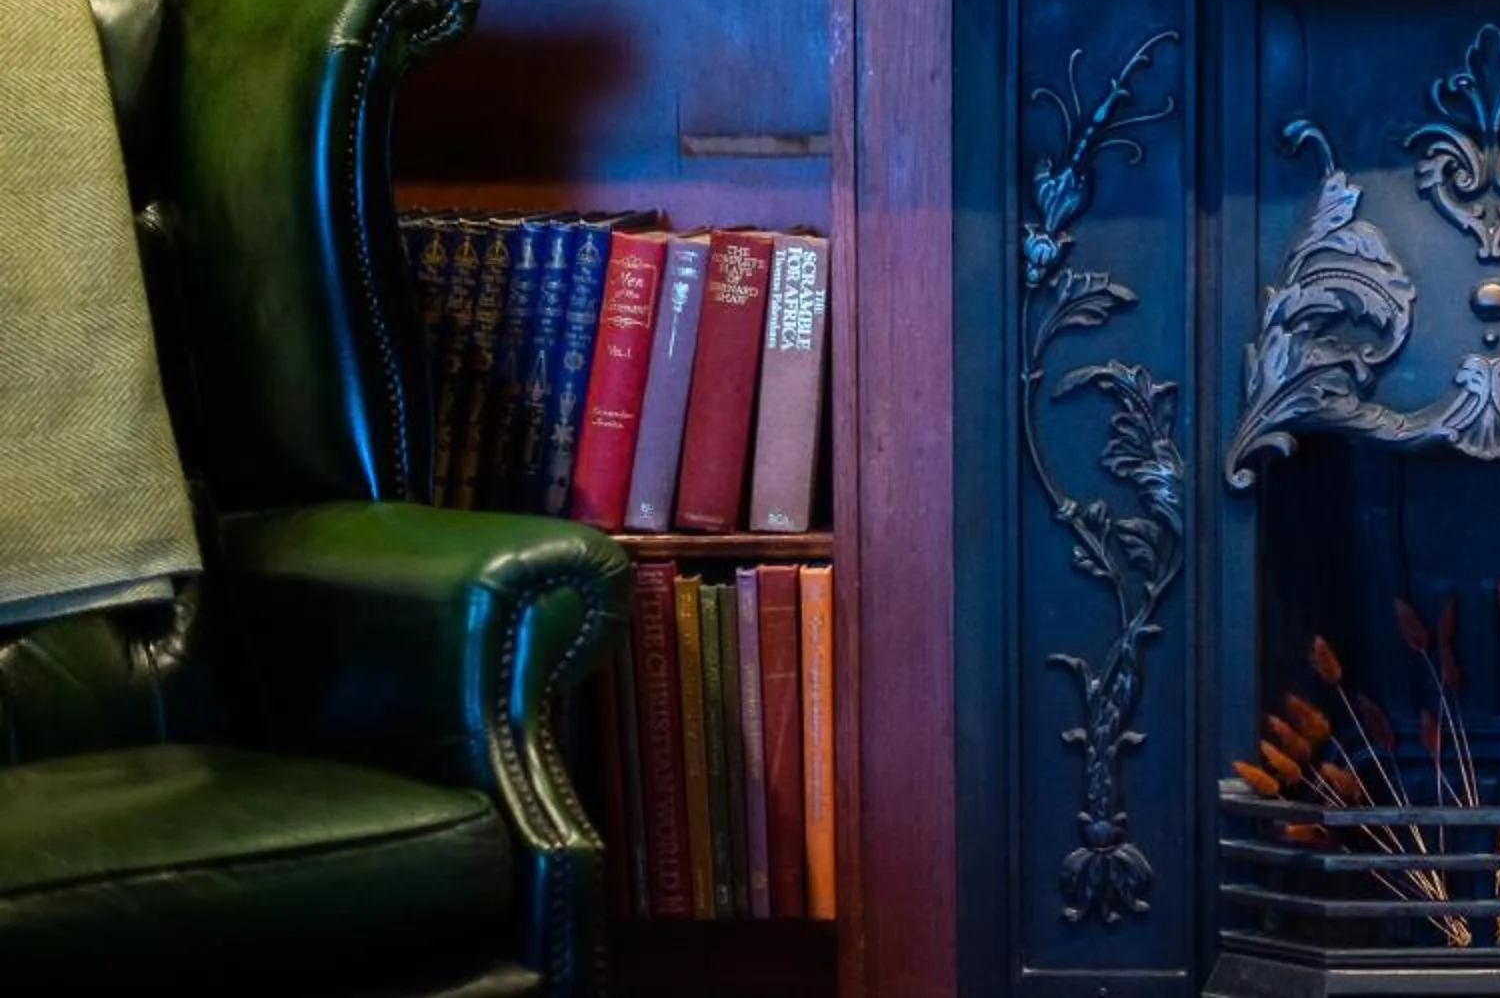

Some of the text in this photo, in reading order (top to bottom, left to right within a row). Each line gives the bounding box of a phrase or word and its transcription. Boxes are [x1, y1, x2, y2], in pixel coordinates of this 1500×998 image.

[773, 250, 787, 291] Thomas
[780, 246, 803, 351] FOR AFRICA
[796, 251, 817, 351] SCRAMBLE
[815, 290, 826, 315] THE
[644, 653, 675, 793] CHRISTIAN
[654, 797, 682, 891] WORLD
